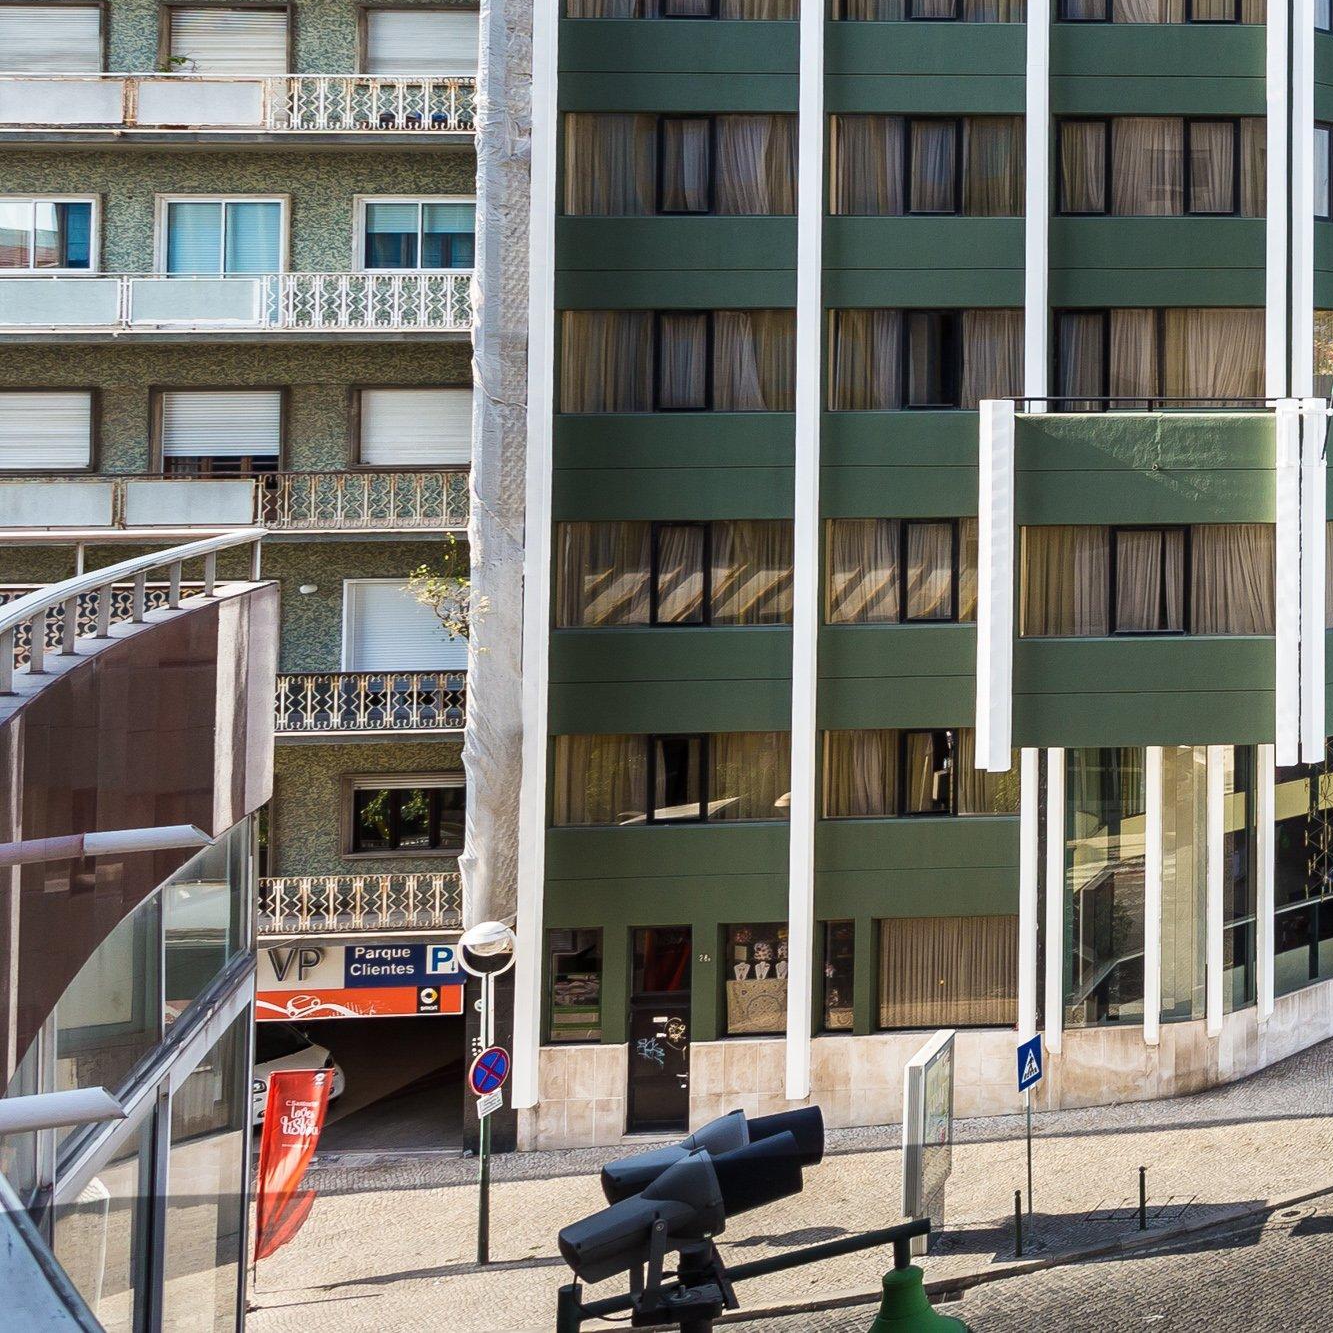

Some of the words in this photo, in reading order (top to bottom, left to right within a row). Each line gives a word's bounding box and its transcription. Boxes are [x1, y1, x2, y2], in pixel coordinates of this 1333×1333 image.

[354, 947, 411, 961] Parque
[431, 947, 454, 972] P
[268, 947, 324, 981] VP
[350, 963, 415, 976] Clientes
